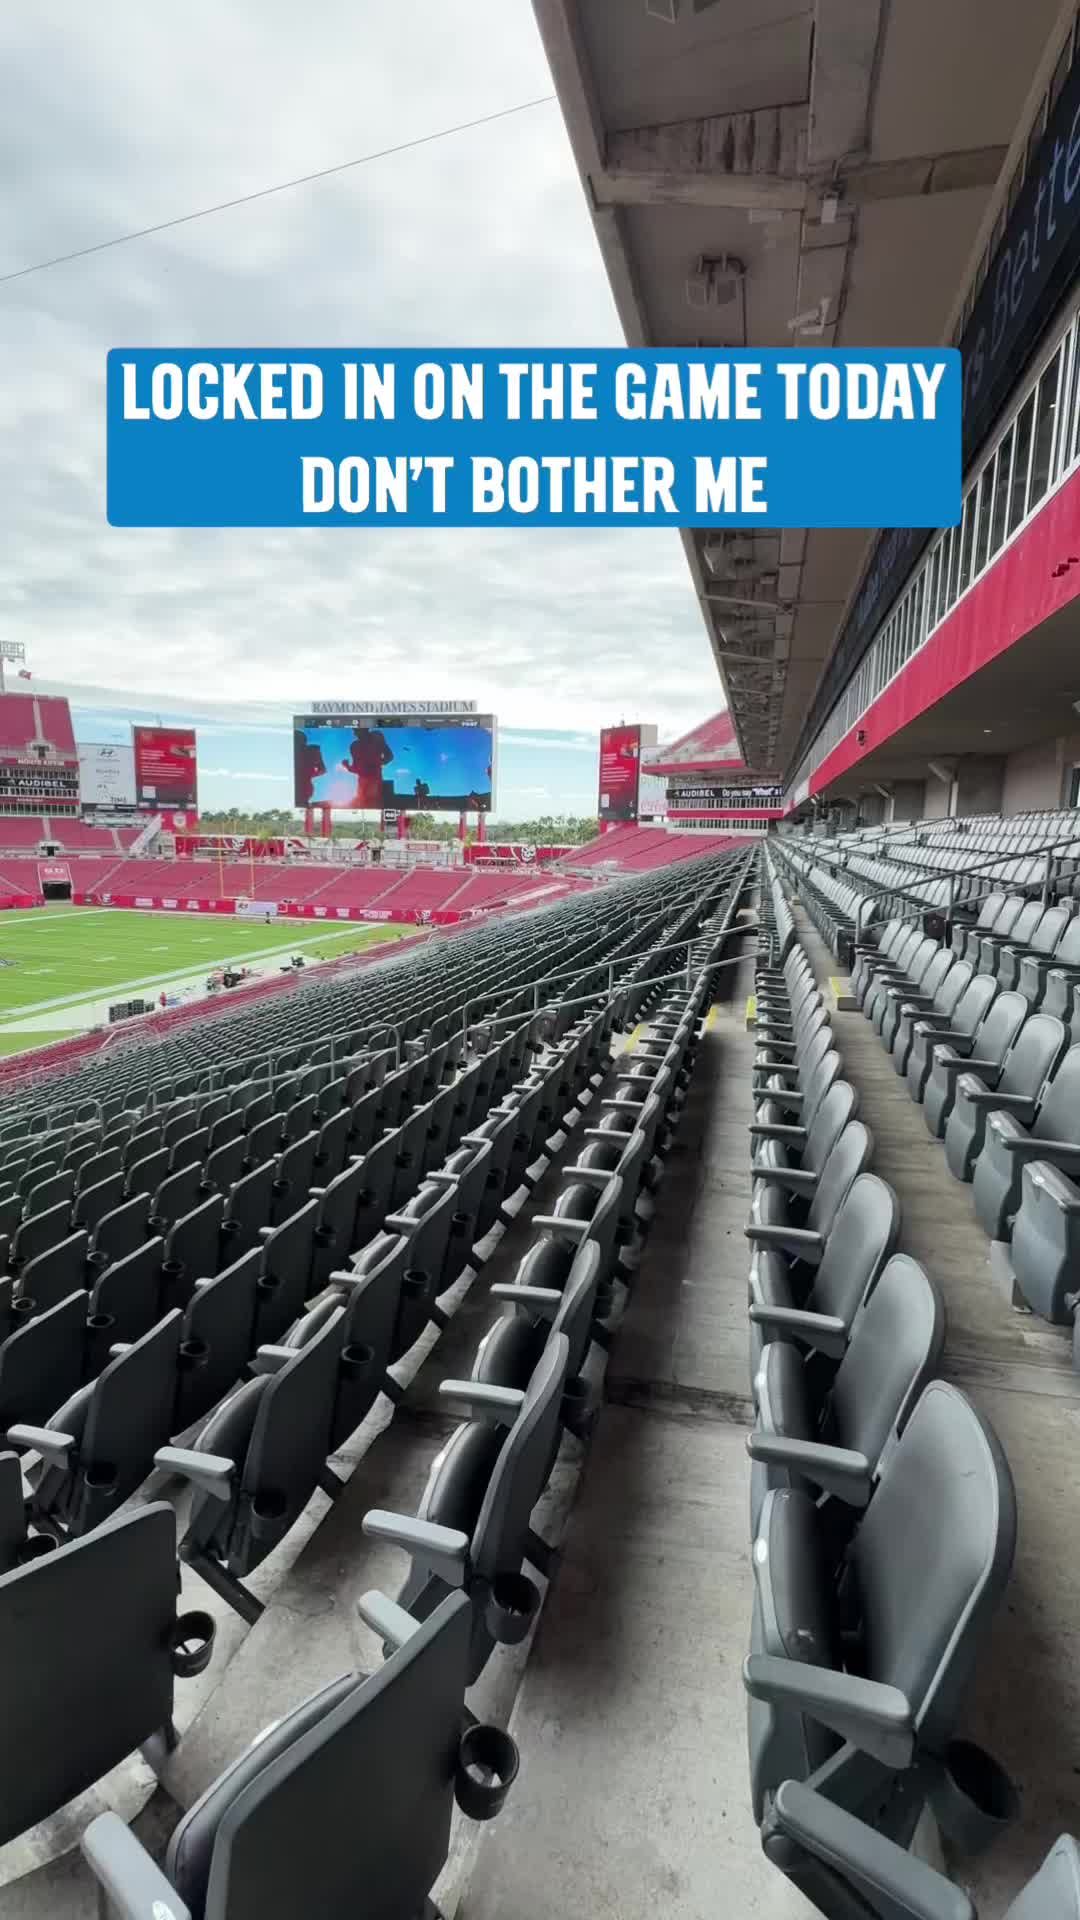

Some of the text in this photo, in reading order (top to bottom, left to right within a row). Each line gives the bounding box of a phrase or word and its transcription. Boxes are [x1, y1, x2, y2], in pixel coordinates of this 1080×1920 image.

[312, 701, 474, 712] RAYMOND JAMES STADIUM
[19, 780, 66, 788] AUDIBEL
